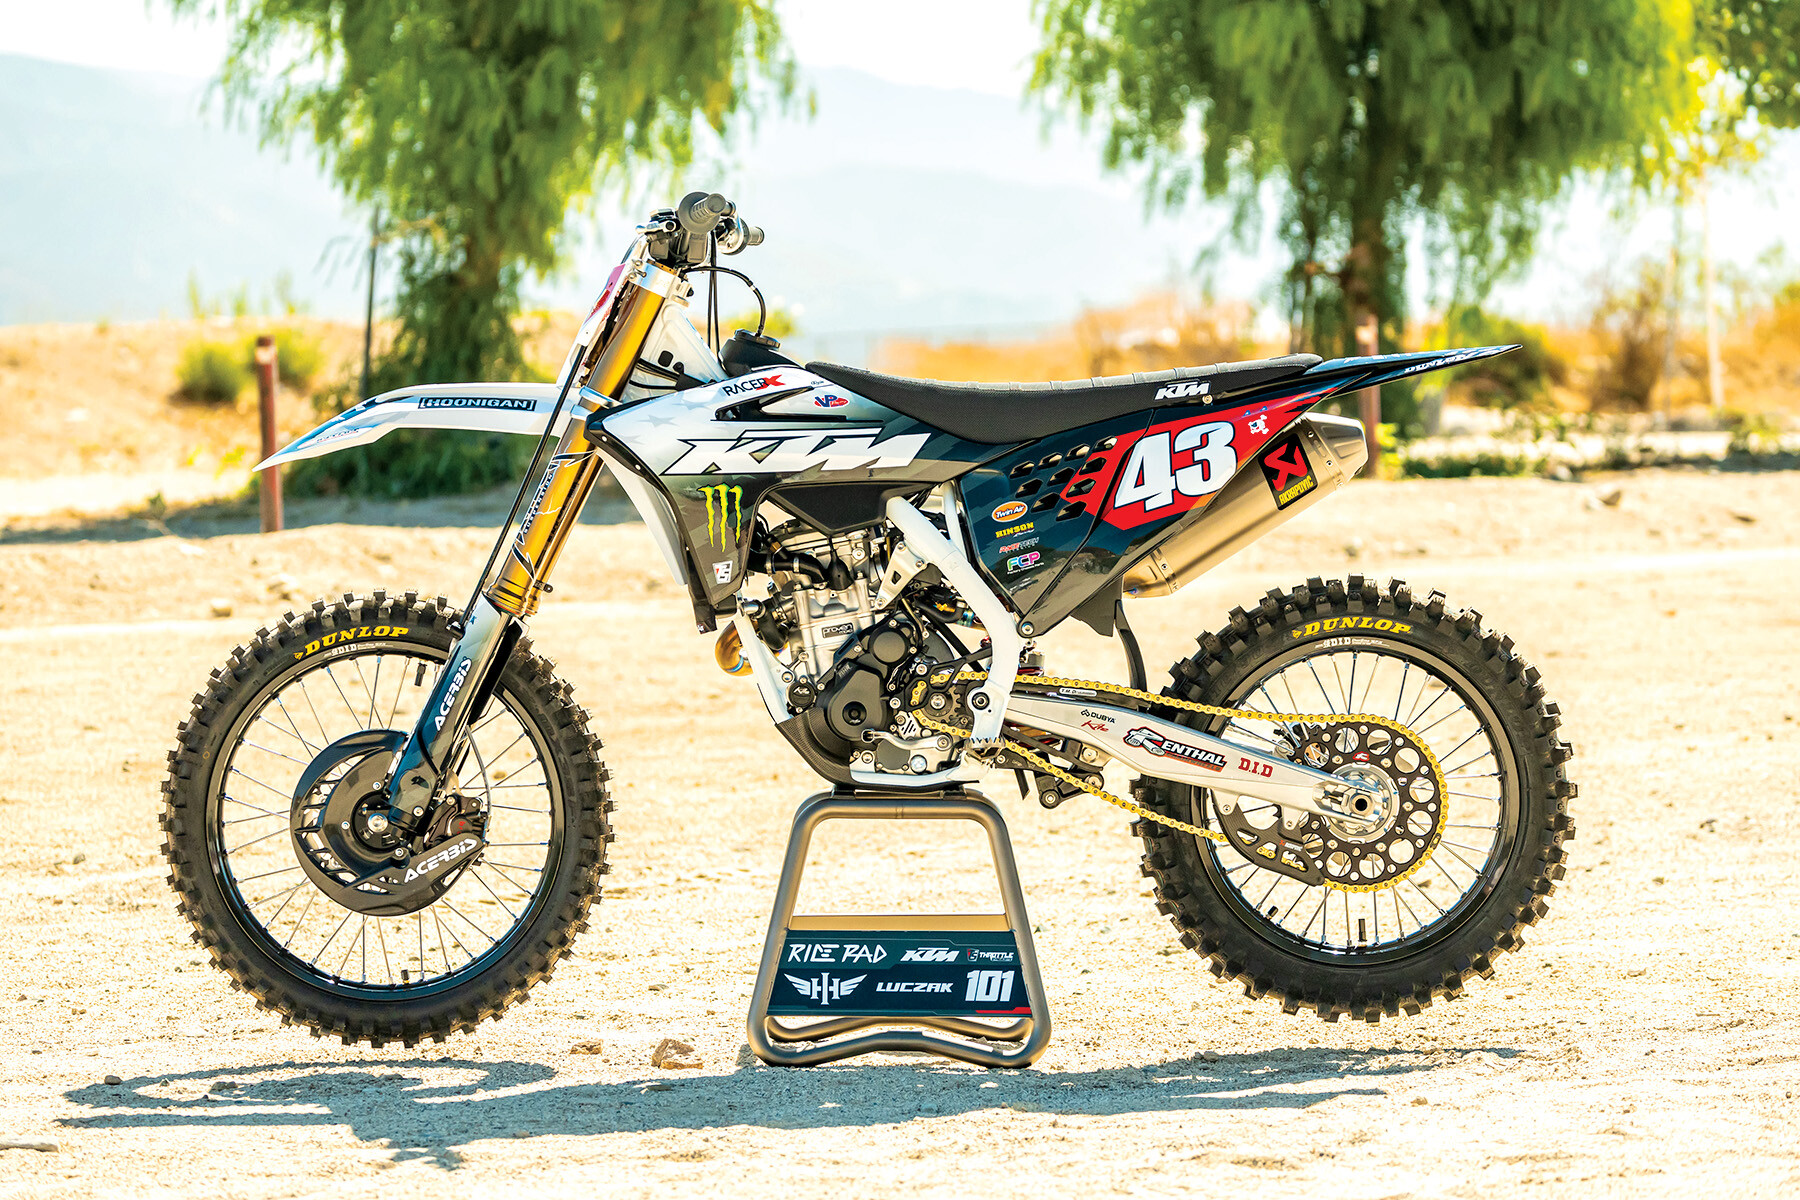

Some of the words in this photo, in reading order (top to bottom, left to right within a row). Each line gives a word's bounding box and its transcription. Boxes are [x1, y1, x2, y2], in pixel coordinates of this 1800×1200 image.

[1155, 381, 1210, 400] KTM
[659, 427, 932, 475] KTM
[1114, 421, 1238, 513] 43
[996, 508, 1013, 519] Twin
[1013, 505, 1026, 513] Air
[995, 522, 1035, 538] HINSON
[1006, 551, 1041, 572] FCP
[1303, 616, 1412, 637] DUNLOP
[304, 625, 409, 656] DUNLOP
[434, 657, 472, 732] ACERBIS
[1090, 711, 1115, 724] DUBYA
[1238, 757, 1274, 778] D.I.D
[404, 838, 478, 884] ACERBIS
[841, 944, 888, 964] RAD
[900, 947, 960, 962] KTM
[979, 951, 1015, 960] THROTTLE
[875, 982, 954, 993] LUCZAK
[964, 969, 1015, 1002] 101
